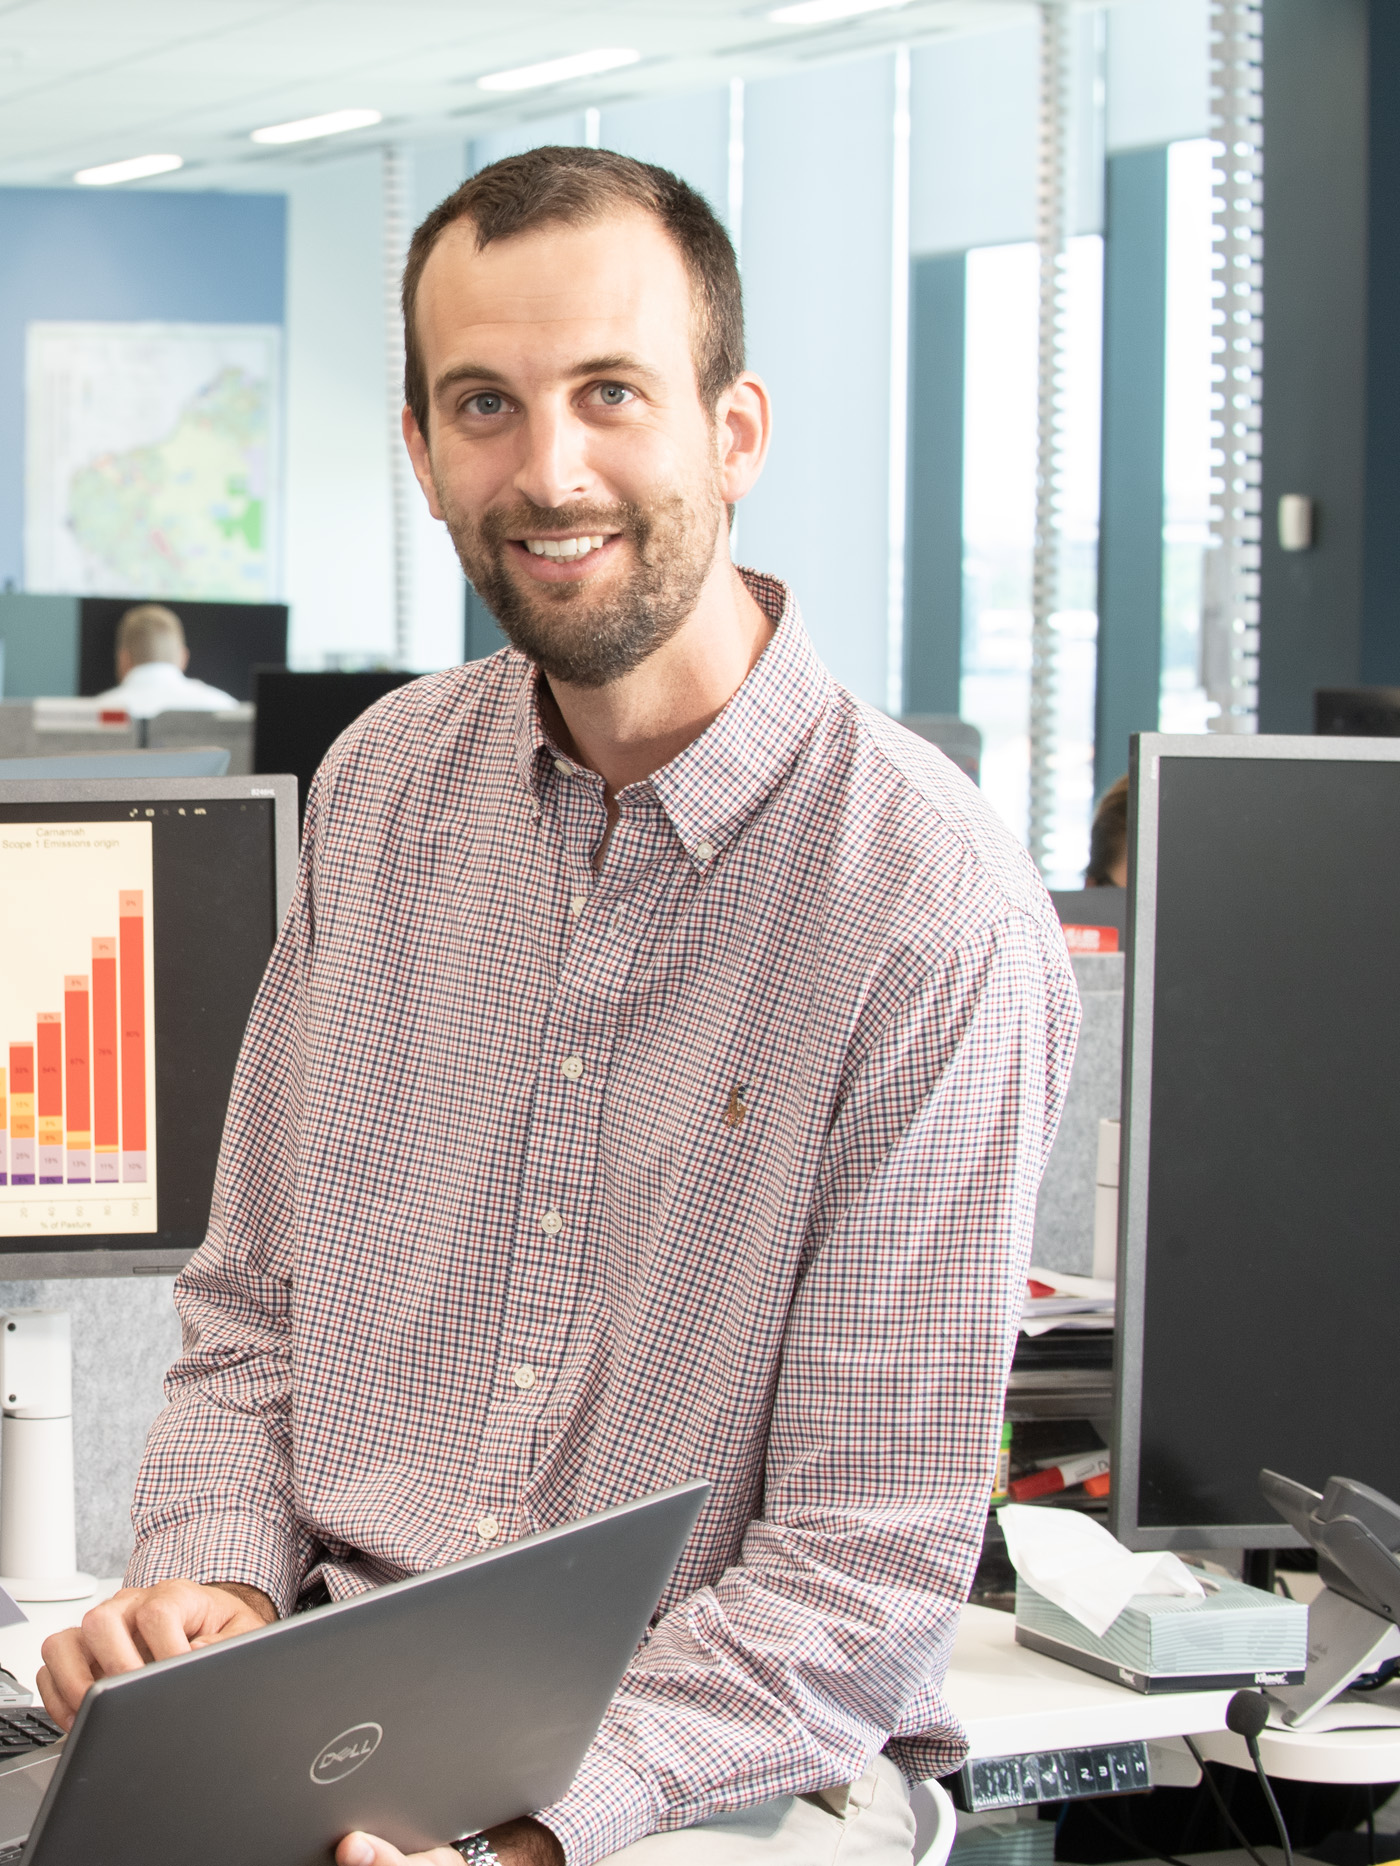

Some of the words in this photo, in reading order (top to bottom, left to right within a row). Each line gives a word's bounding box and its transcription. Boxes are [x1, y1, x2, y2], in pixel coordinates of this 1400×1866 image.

[36, 828, 85, 837] Carnamah
[2, 840, 32, 850] Scope
[44, 839, 91, 848] Emissions
[93, 838, 120, 849] origin
[318, 1740, 371, 1769] DELL
[1080, 1768, 1090, 1779] 2
[1099, 1766, 1108, 1776] 3
[1117, 1764, 1127, 1774] 4
